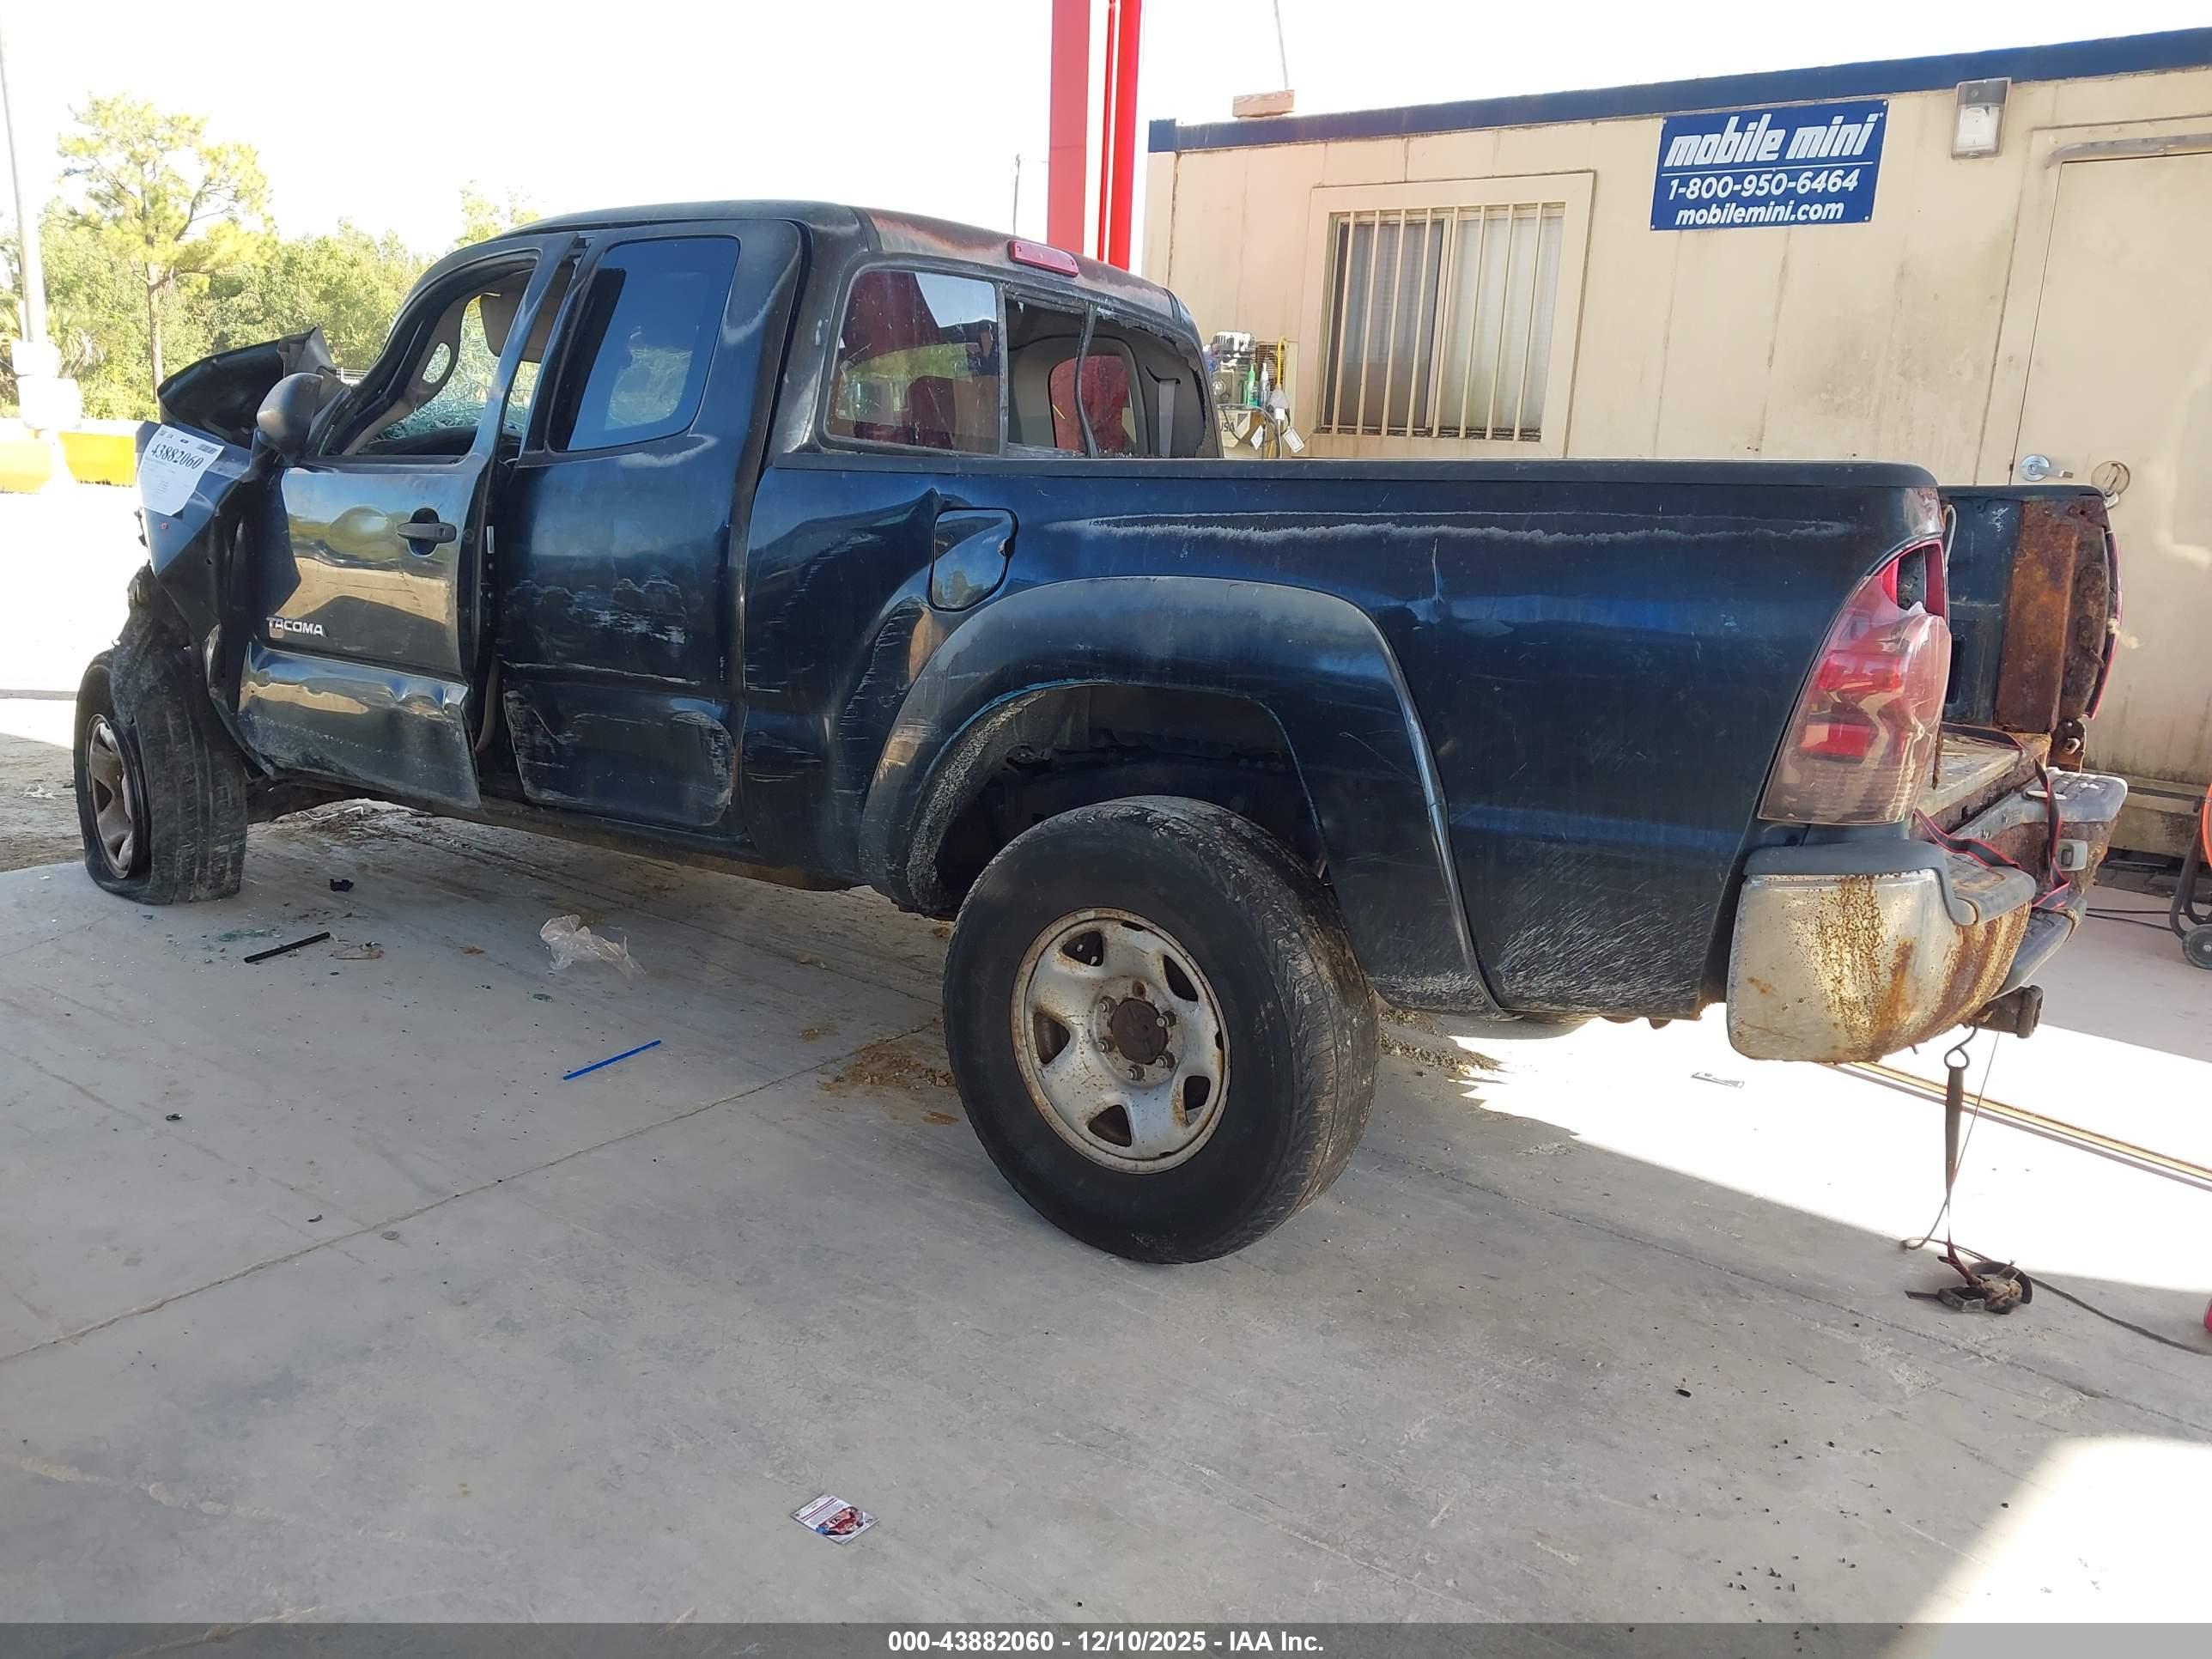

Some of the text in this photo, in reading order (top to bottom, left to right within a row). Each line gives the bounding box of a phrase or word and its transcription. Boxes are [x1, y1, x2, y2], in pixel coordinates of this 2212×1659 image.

[1663, 112, 1879, 167] mobile mini
[1668, 168, 1860, 200] 1-800-950-6464
[1674, 200, 1844, 225] mobilemini.com
[150, 442, 204, 470] 43882060
[266, 617, 324, 636] TACOMA
